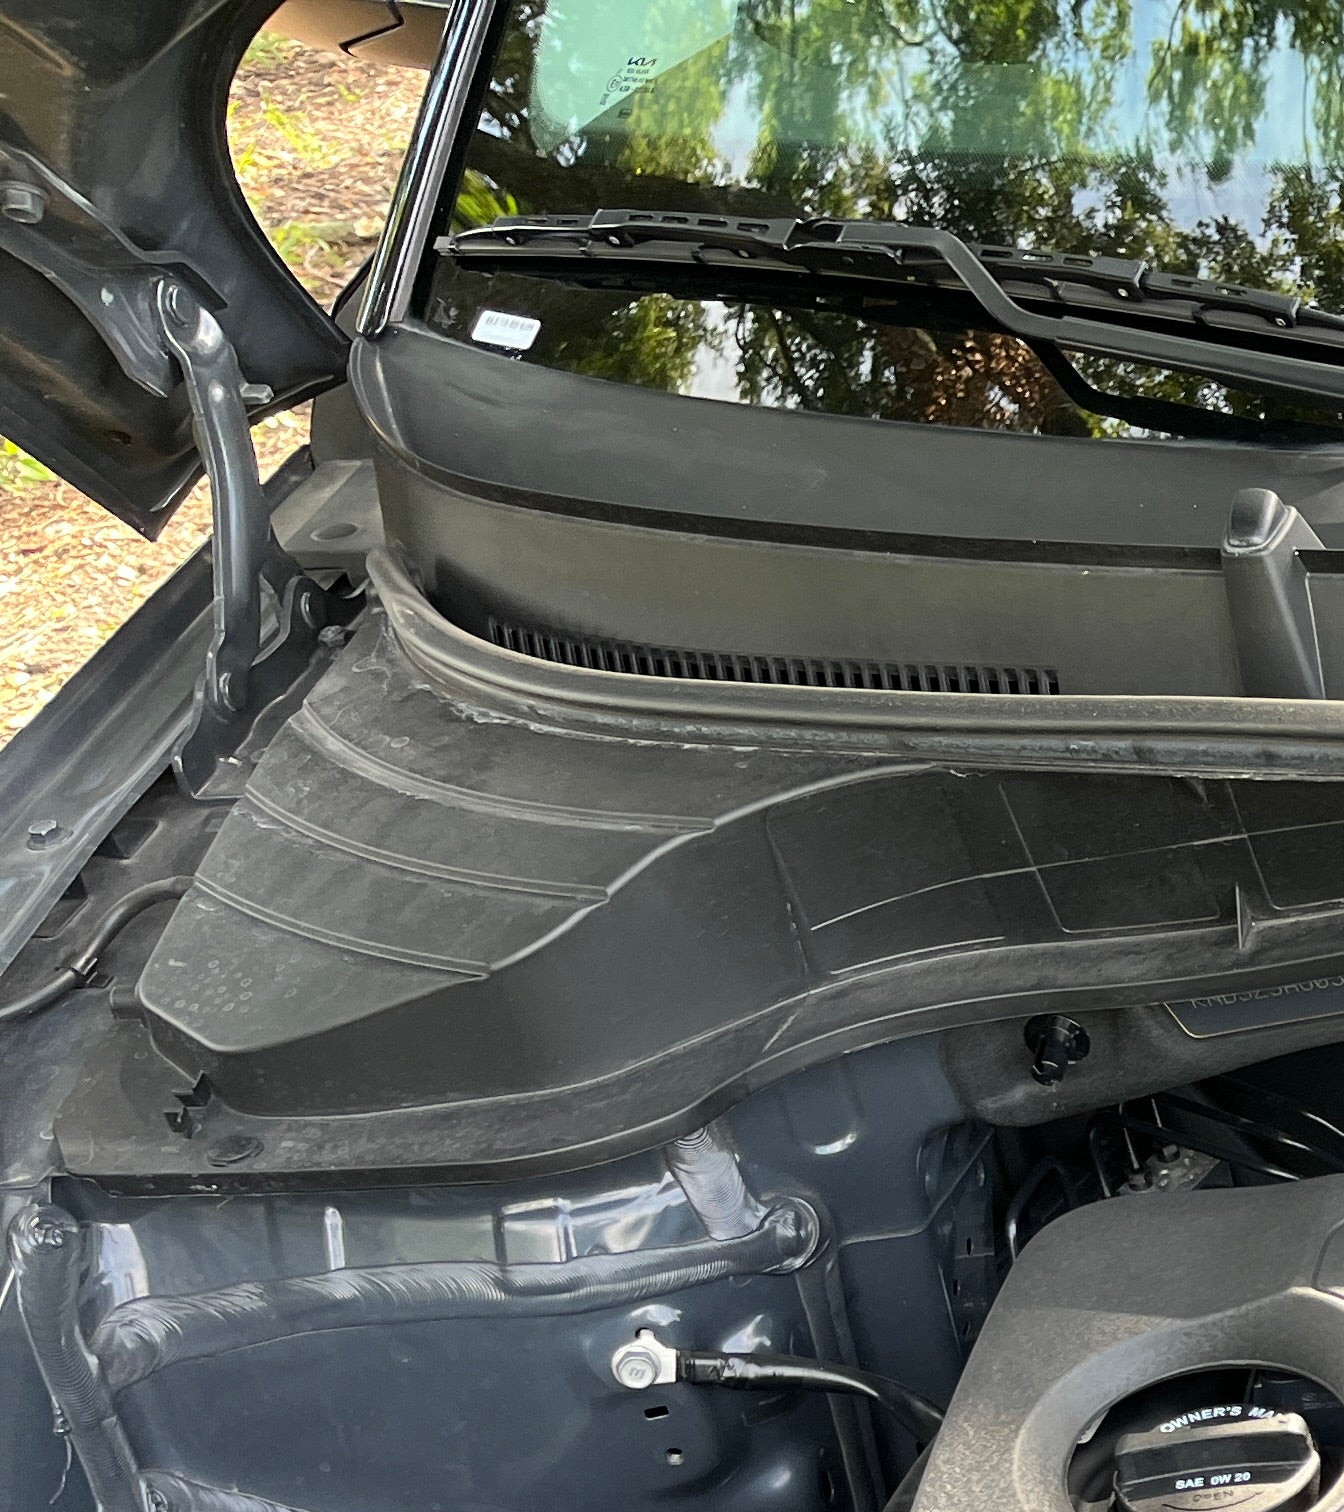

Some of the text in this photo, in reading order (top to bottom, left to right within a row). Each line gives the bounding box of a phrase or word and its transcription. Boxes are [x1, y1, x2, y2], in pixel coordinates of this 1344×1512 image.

[1160, 1405, 1242, 1433] OWNER'S
[1175, 1476, 1204, 1490] SAE
[1233, 1471, 1252, 1482] 20
[1192, 1489, 1234, 1503] OPEN
